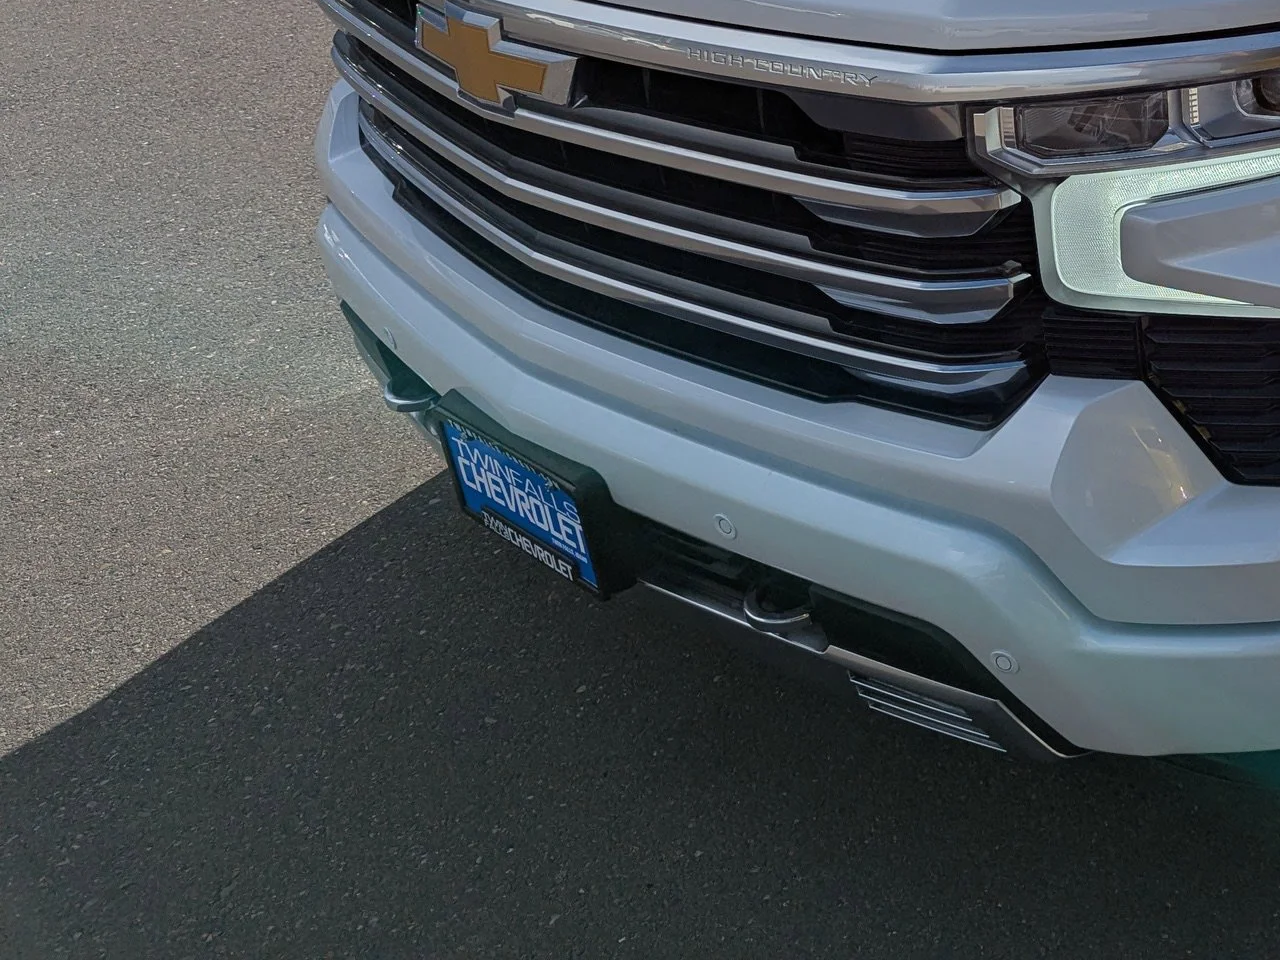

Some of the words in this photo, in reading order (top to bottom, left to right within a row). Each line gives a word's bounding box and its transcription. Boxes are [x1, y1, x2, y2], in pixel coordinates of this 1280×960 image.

[687, 47, 744, 67] HIGH
[754, 59, 878, 87] COUNTRY
[457, 456, 586, 554] CHEVROLET
[508, 528, 574, 581] CHEVROLET
